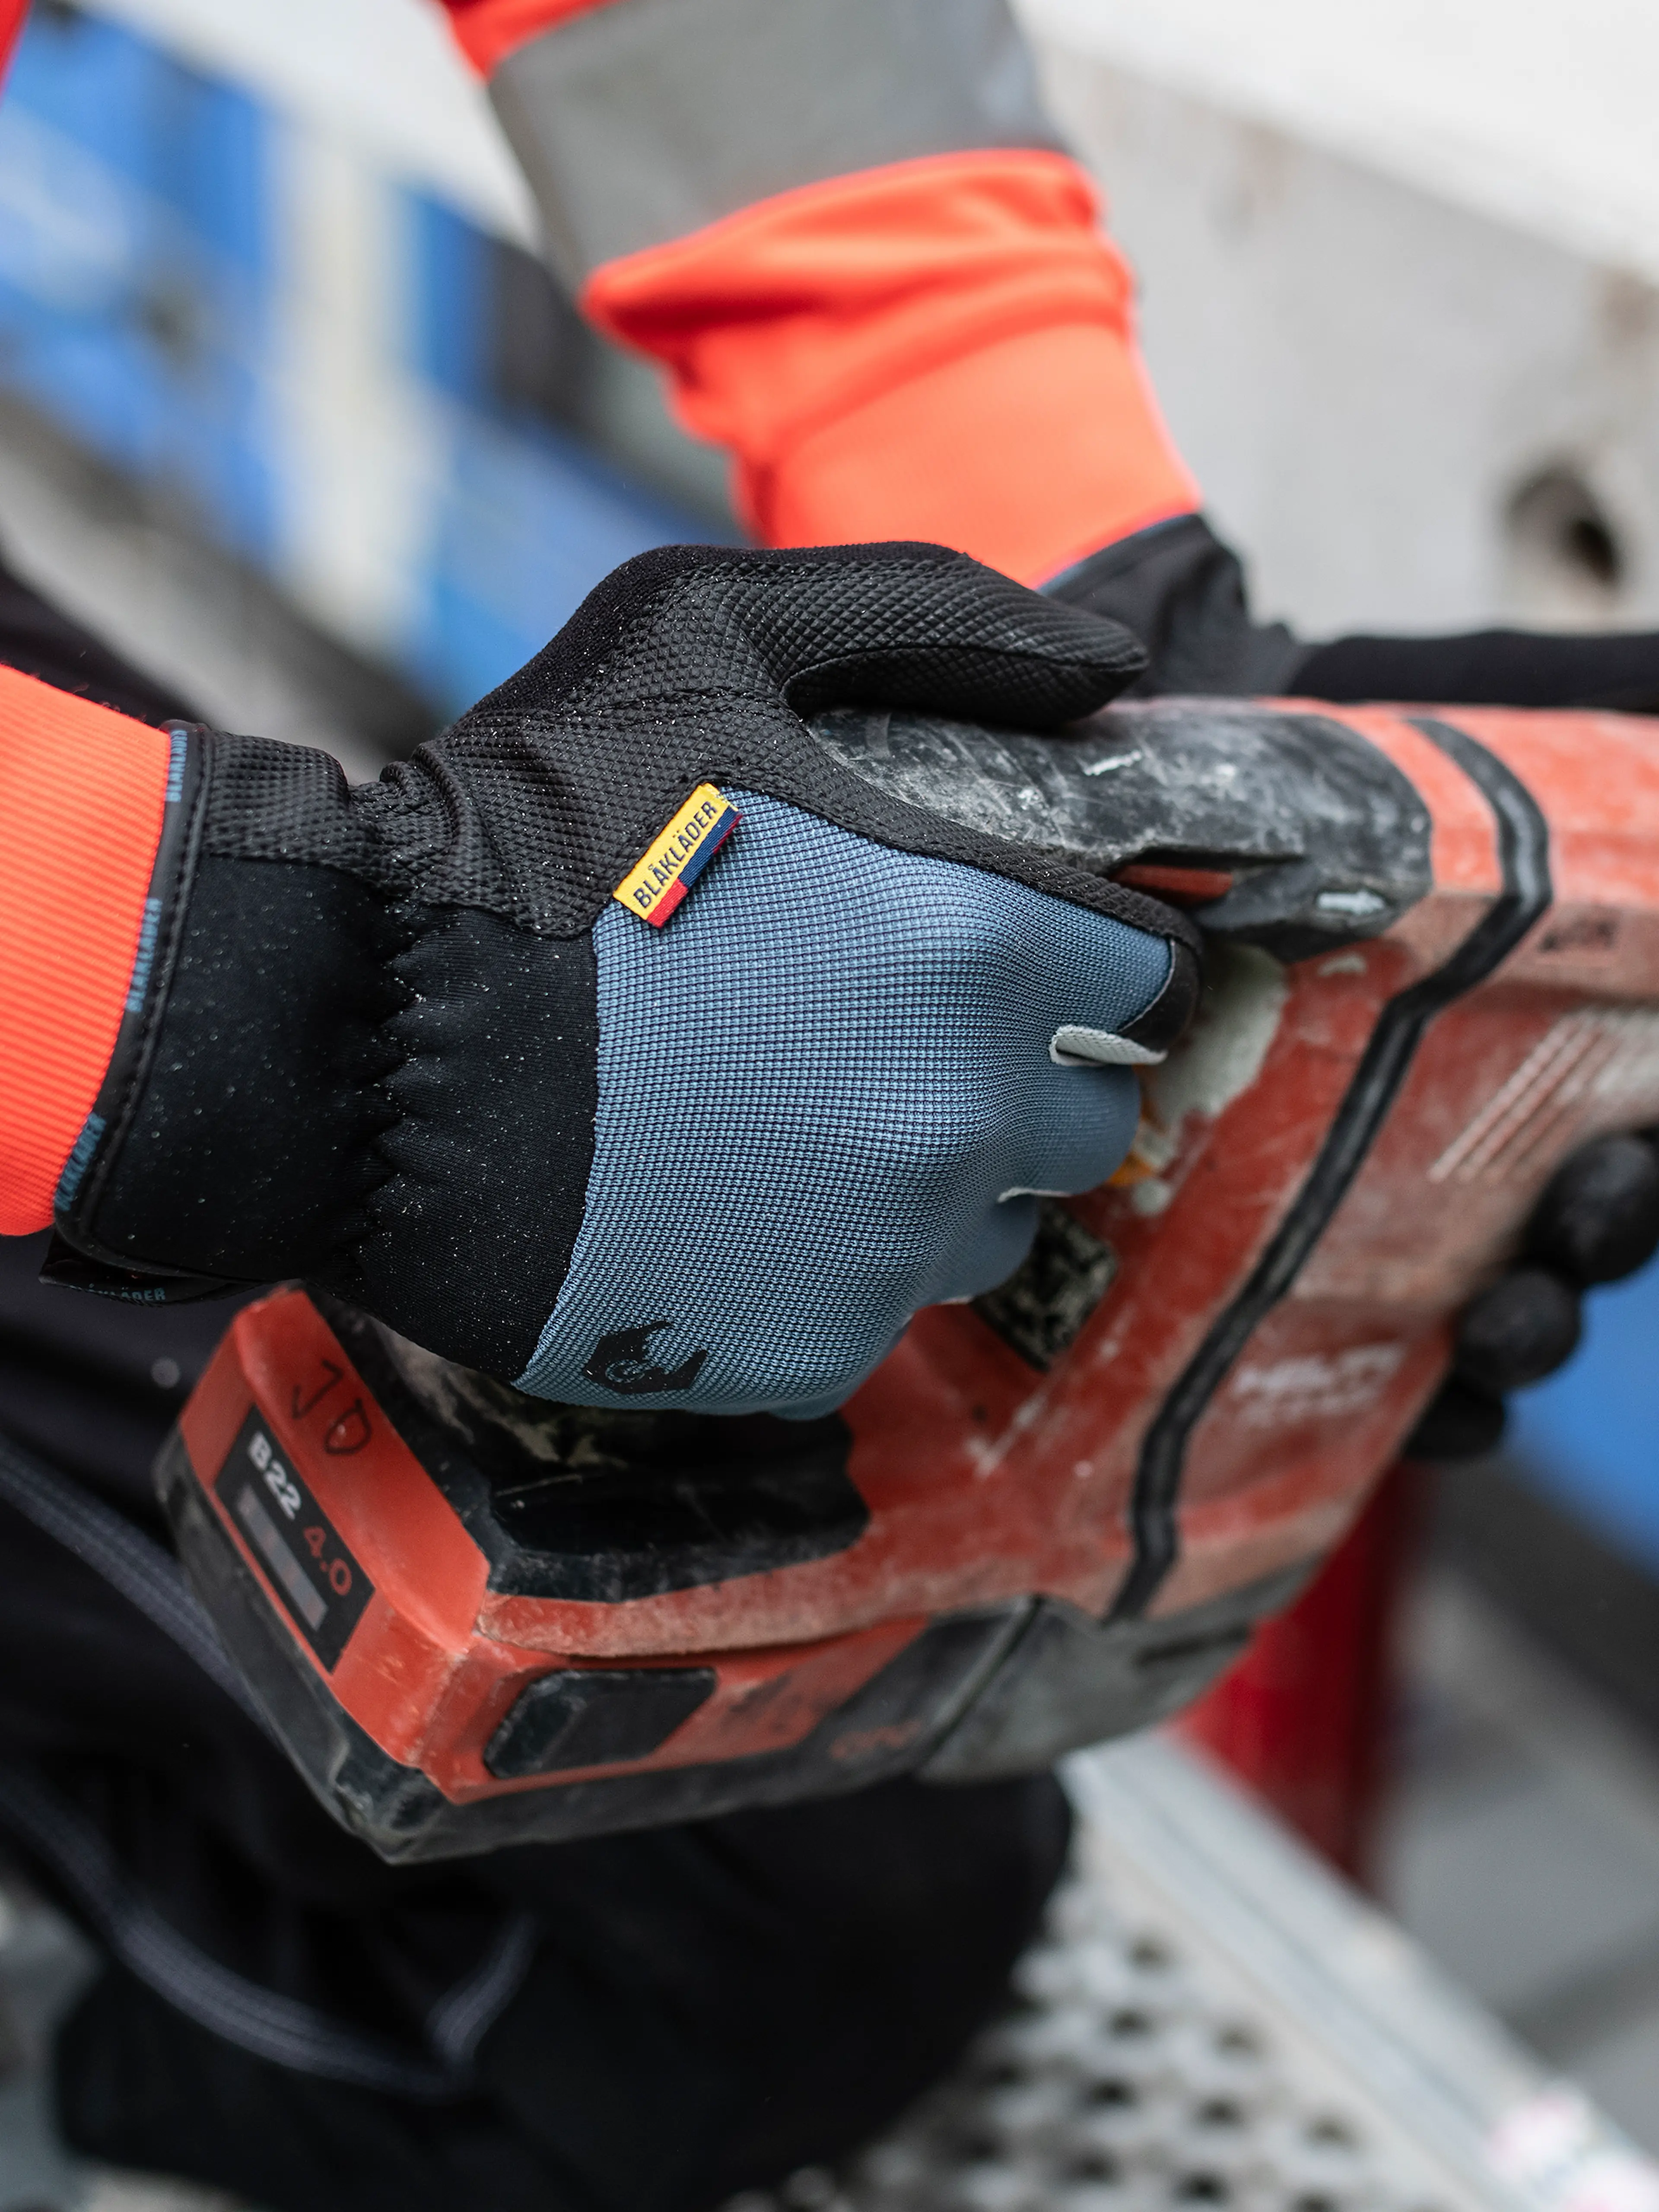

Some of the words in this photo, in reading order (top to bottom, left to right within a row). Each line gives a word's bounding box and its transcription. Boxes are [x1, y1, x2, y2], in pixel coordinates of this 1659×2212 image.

[633, 801, 718, 908] BLÅKLÄDER
[248, 1432, 302, 1520] B22
[304, 1526, 352, 1596] 4.0
